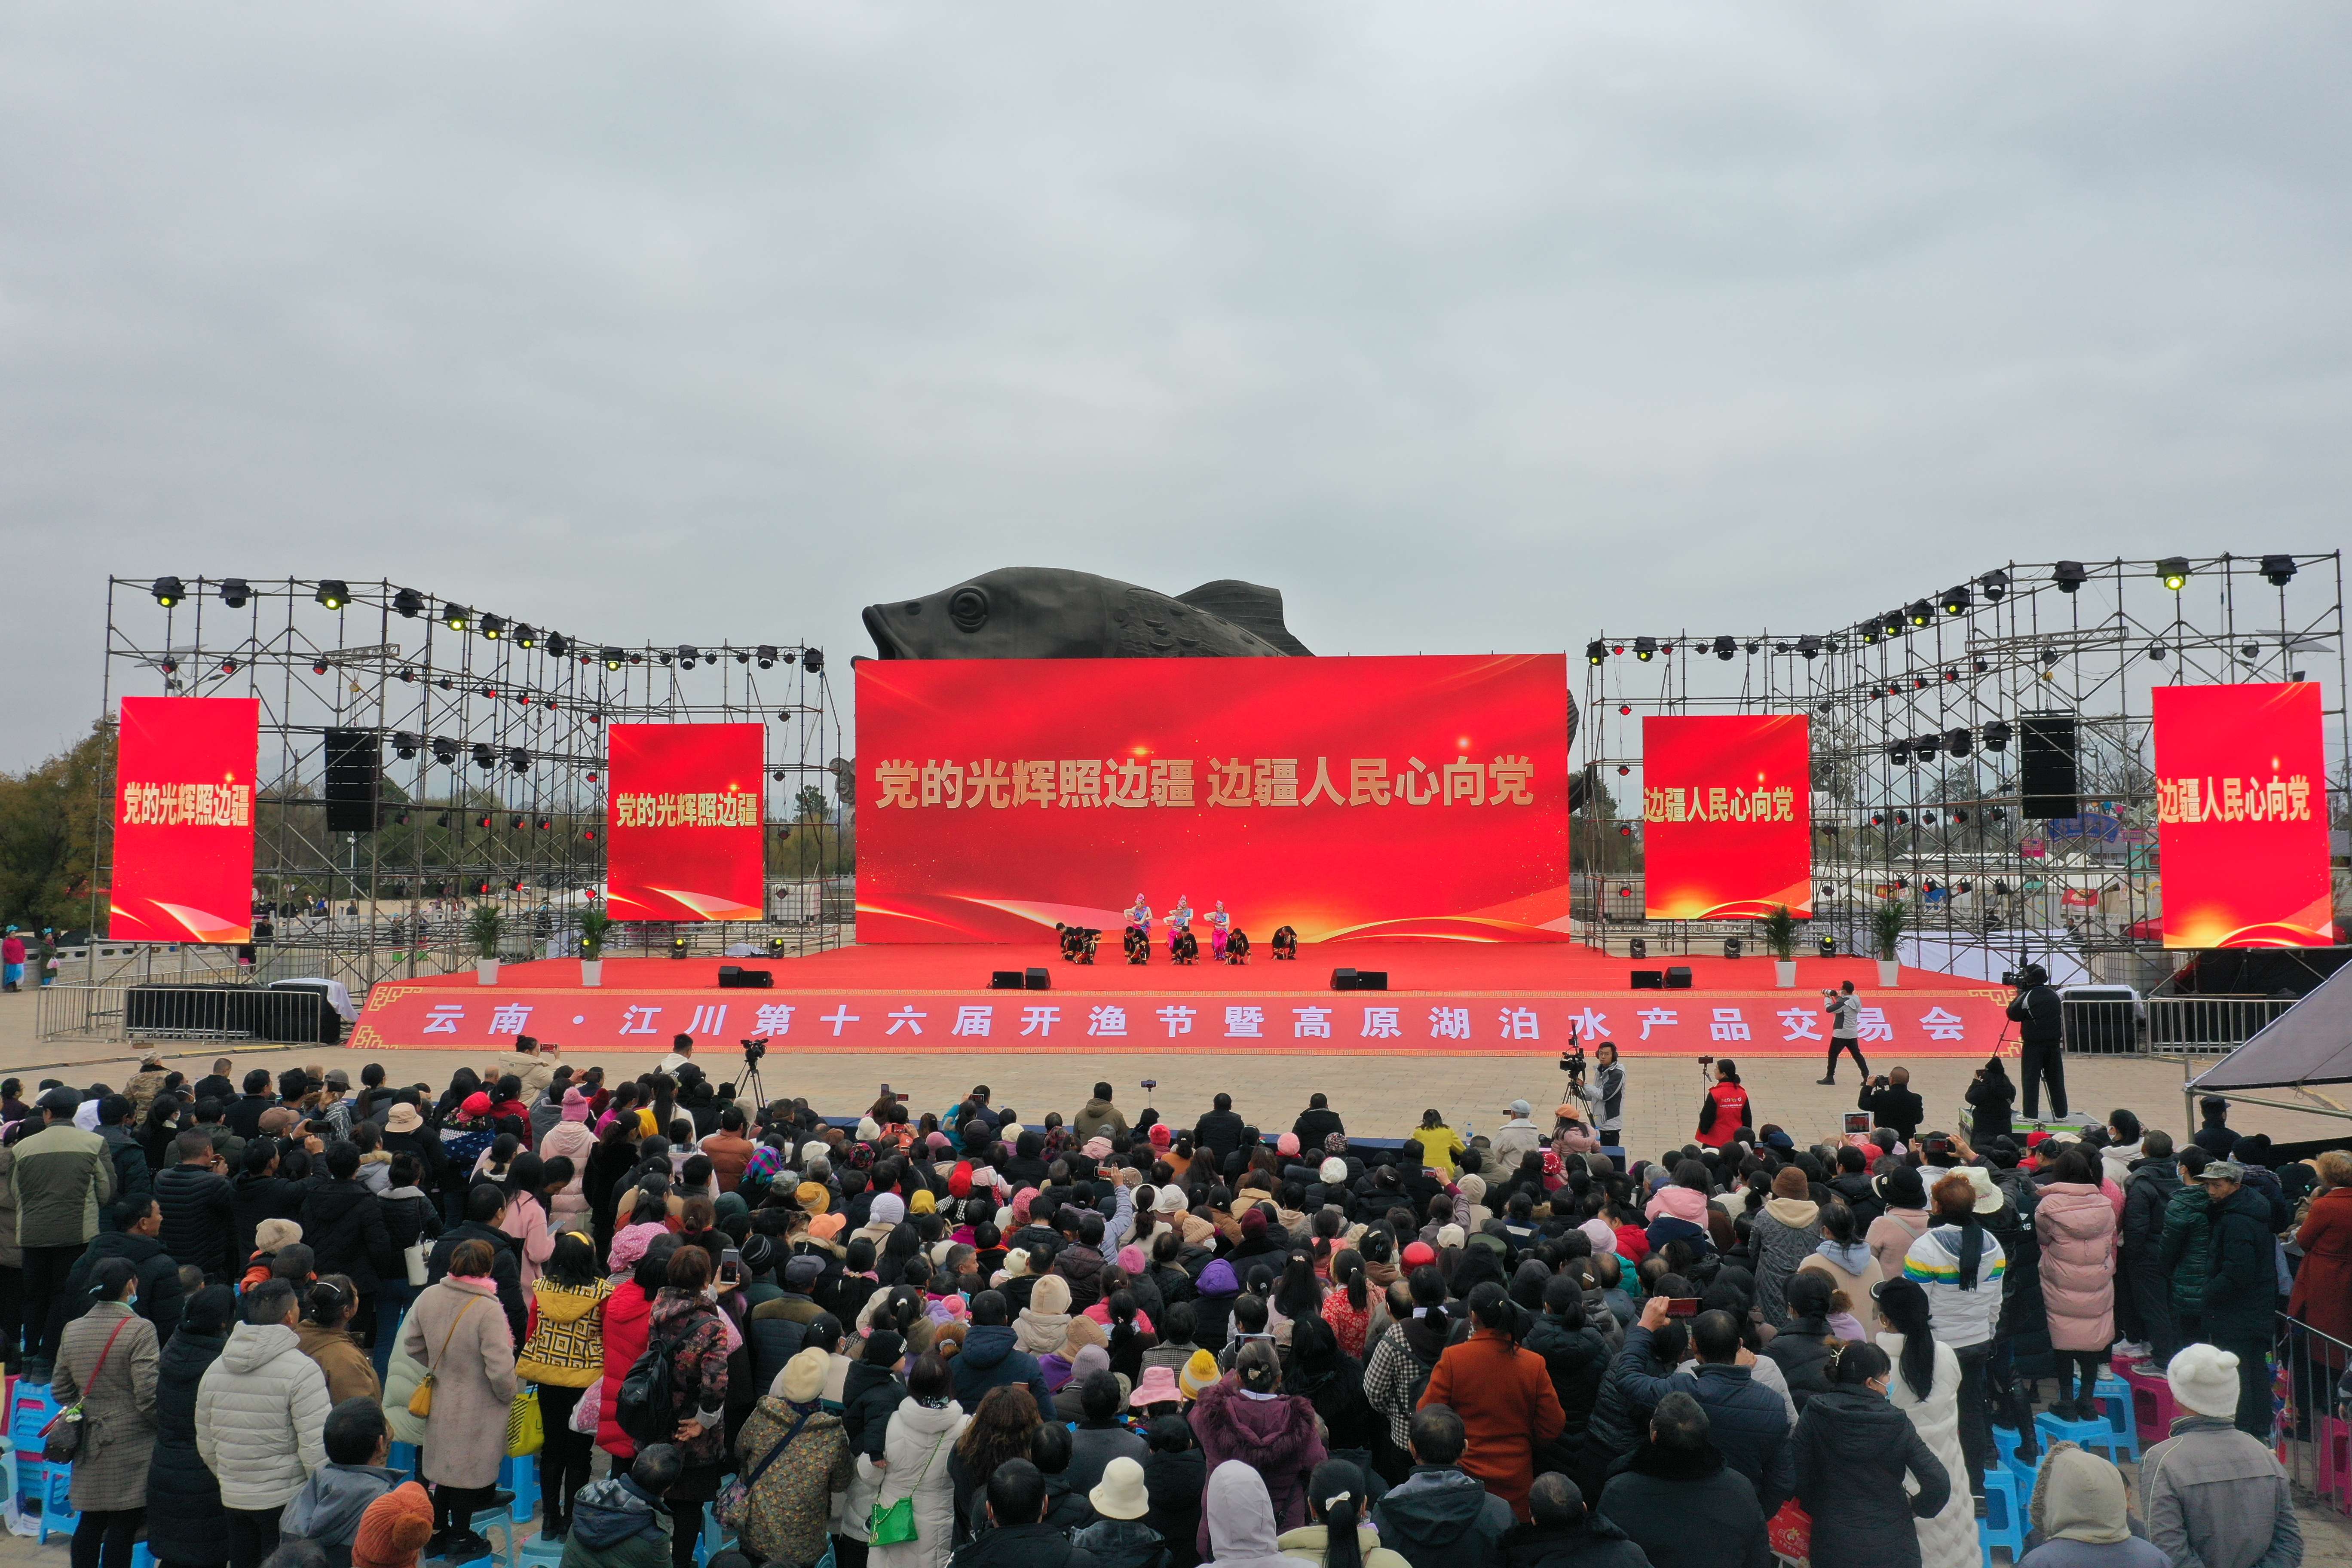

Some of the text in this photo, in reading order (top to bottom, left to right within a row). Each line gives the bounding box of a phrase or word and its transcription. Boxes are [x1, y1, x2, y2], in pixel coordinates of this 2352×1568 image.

[123, 781, 249, 826] 党的光辉照边疆
[876, 756, 1534, 808] 党的光辉照边疆 边疆人民心向党
[1644, 786, 1794, 822] 边疆人民心向党
[2157, 775, 2310, 823] 边疆人民心向党
[616, 792, 757, 827] 党的光辉照边疆
